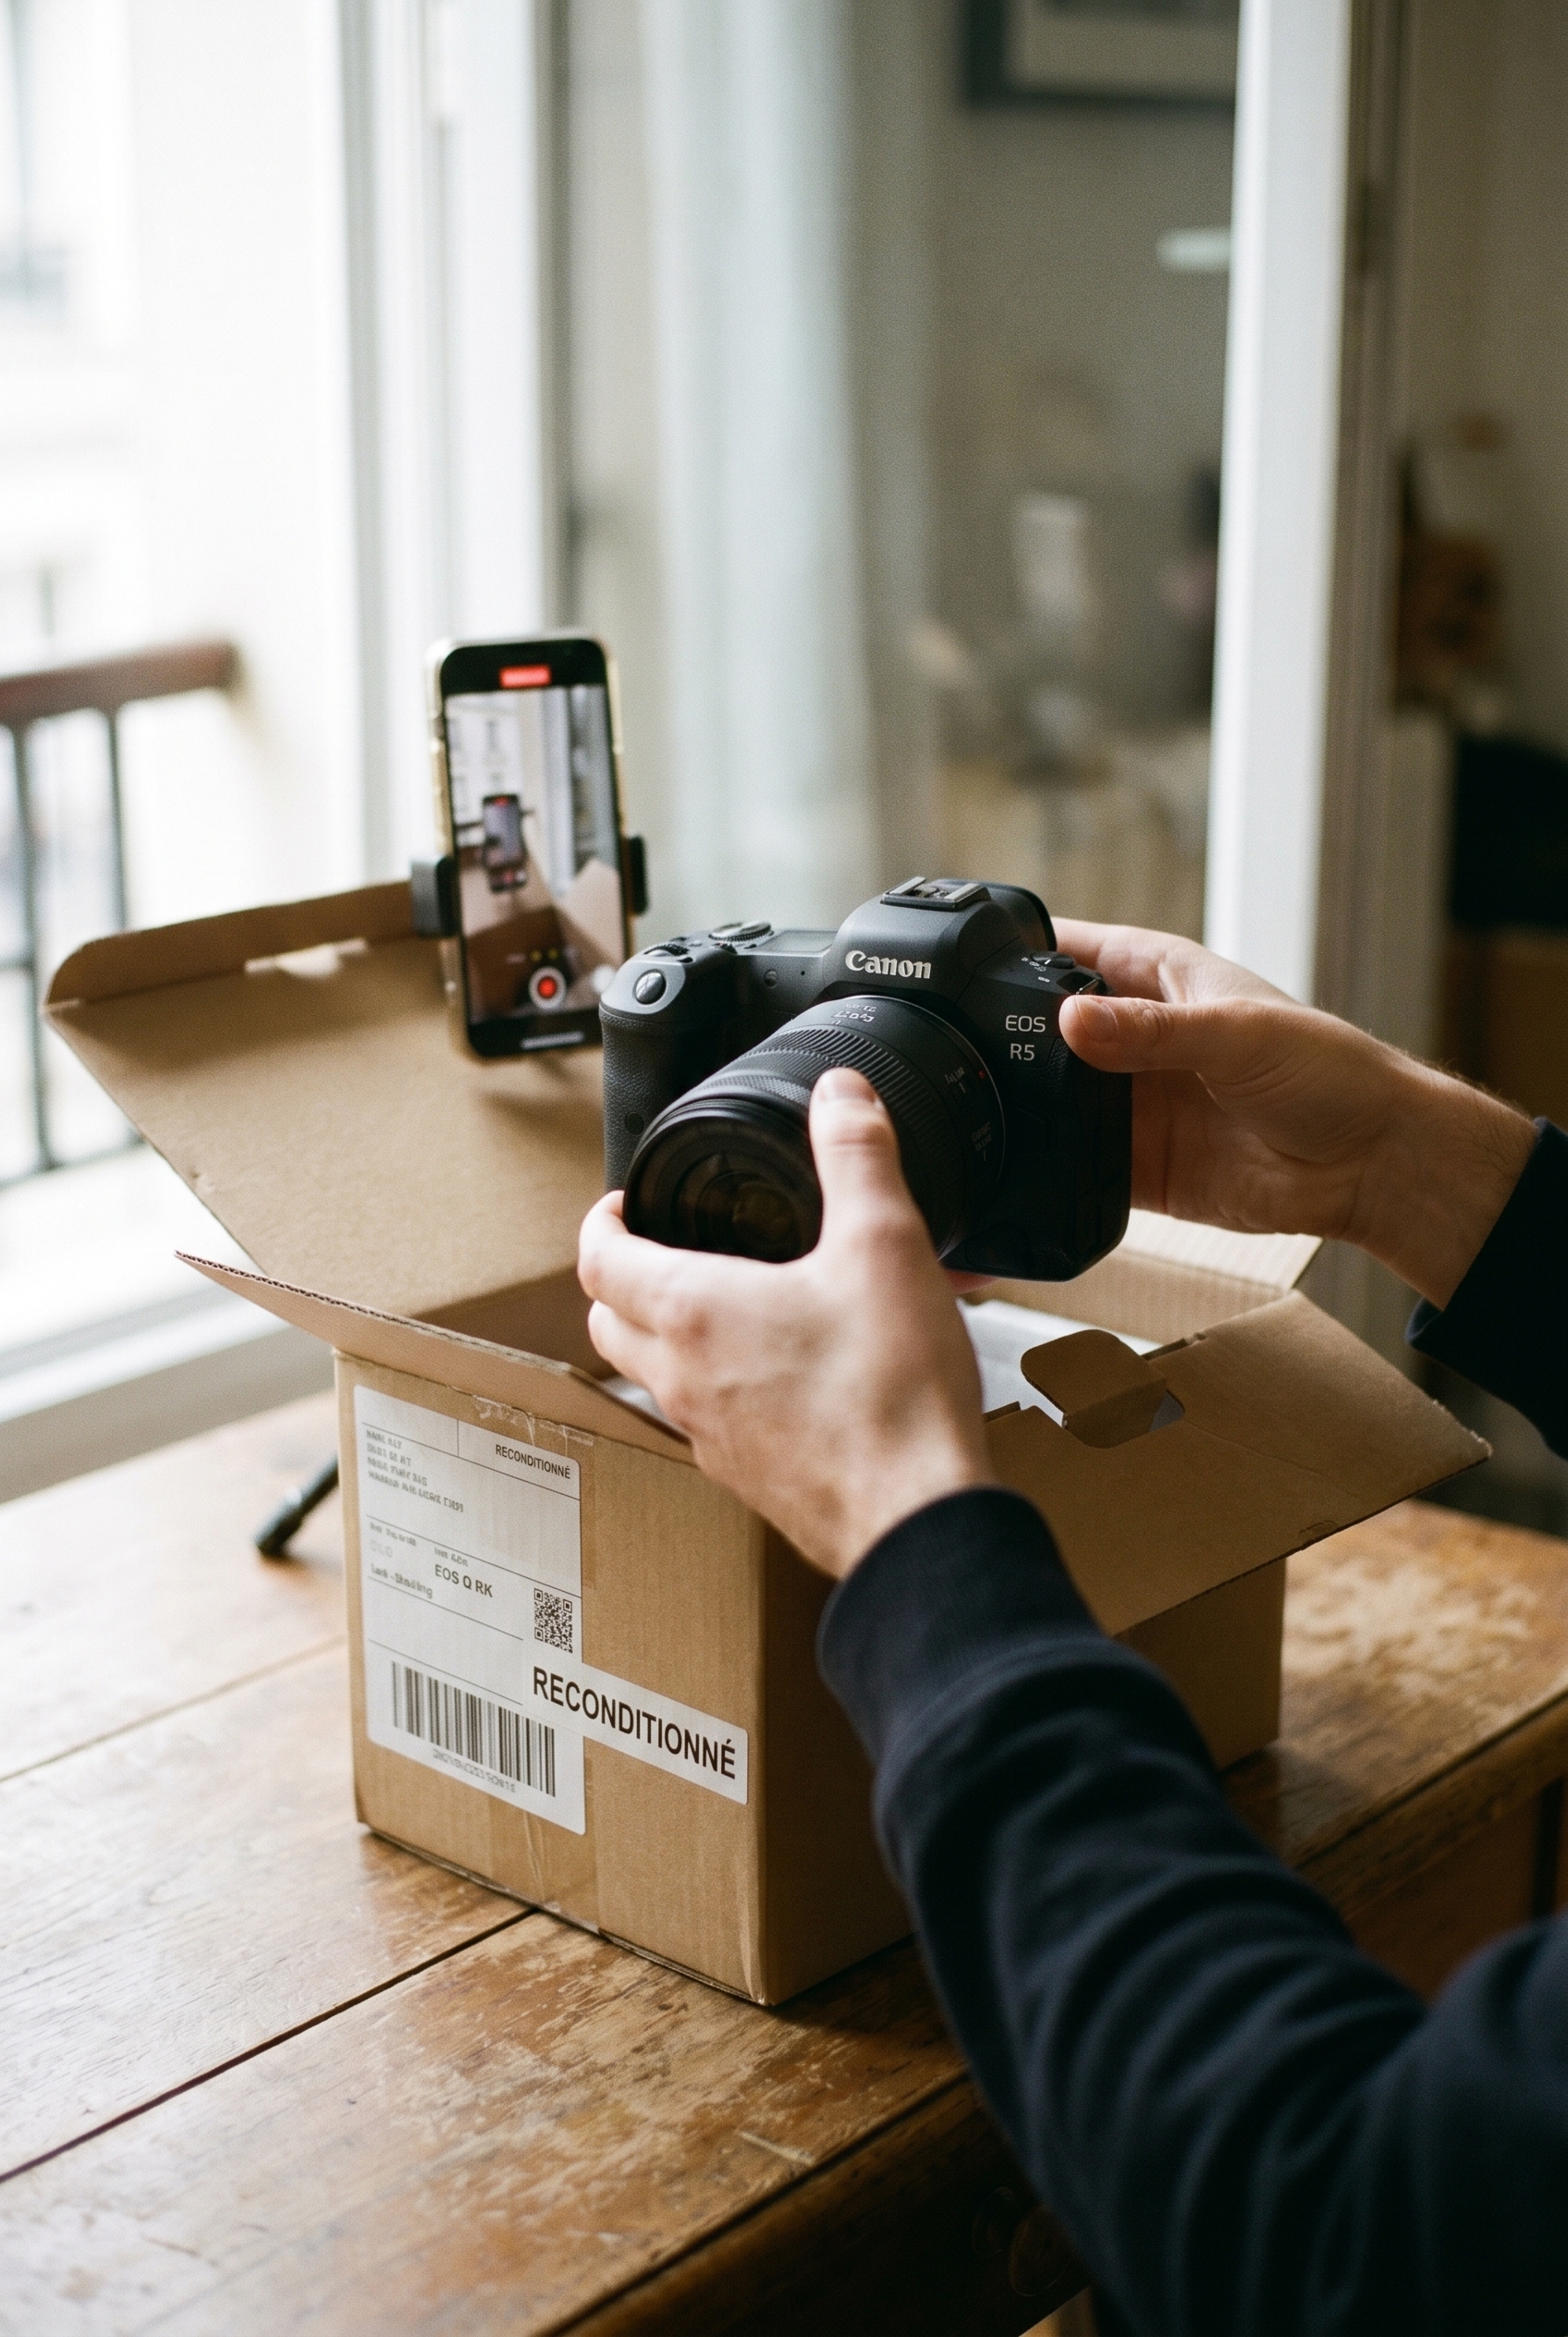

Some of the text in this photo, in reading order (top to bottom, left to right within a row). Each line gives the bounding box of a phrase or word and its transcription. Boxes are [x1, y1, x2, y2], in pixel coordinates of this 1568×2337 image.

[845, 949, 932, 979] Canon
[1005, 1015, 1046, 1033] EOS
[1010, 1043, 1035, 1061] R5
[496, 1444, 570, 1479] RECONDITIONNÉ
[435, 1564, 459, 1585] EOS
[462, 1575, 472, 1590] Q
[475, 1579, 493, 1597] RK
[533, 1665, 736, 1780] RECONDITIONNÉ
